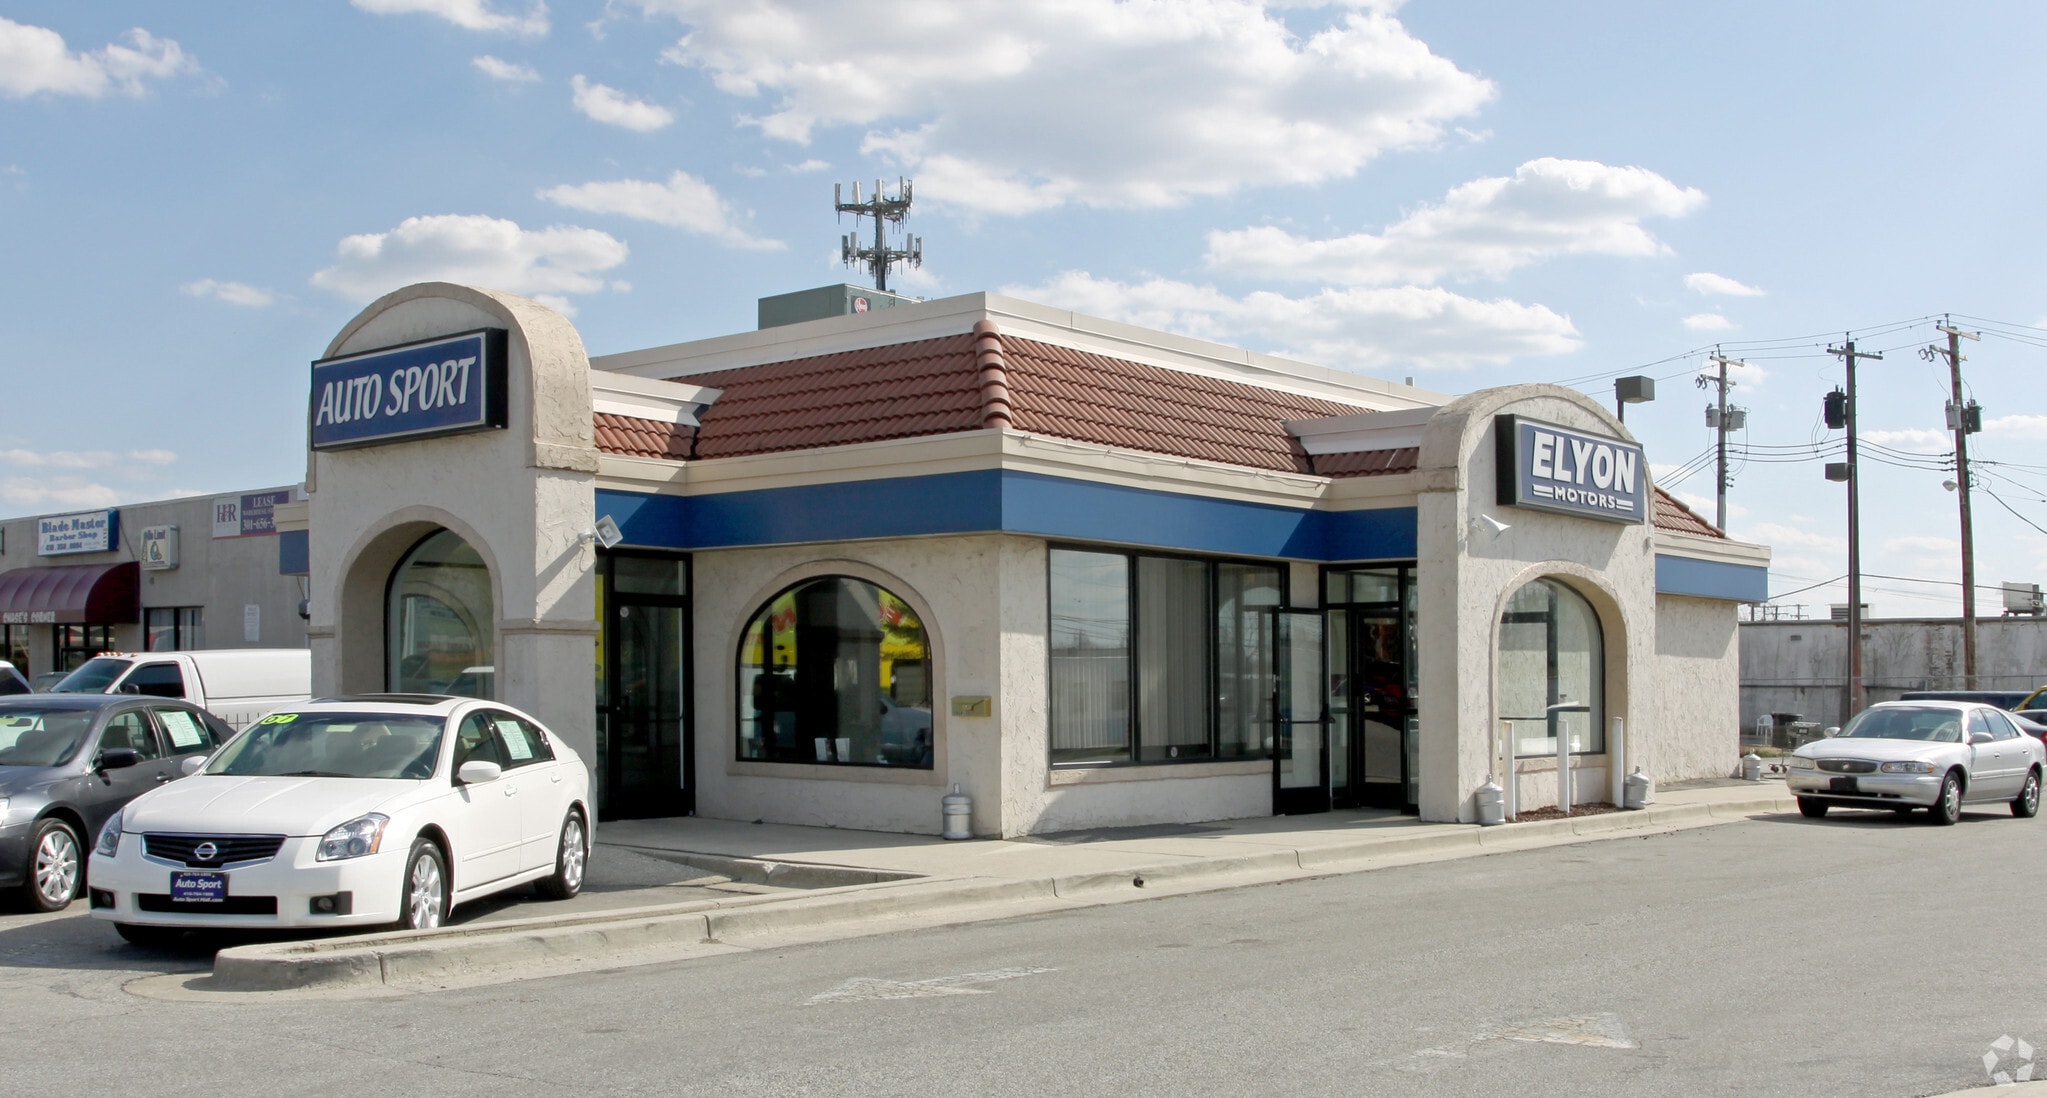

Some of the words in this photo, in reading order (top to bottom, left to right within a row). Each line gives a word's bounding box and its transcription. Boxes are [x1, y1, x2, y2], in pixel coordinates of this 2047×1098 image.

[316, 373, 382, 426] AUTO
[385, 356, 477, 416] SPORT
[1532, 431, 1636, 494] ELYON
[1554, 486, 1616, 509] MOTORS
[42, 520, 69, 533] Blade
[72, 518, 106, 530] Master
[50, 533, 76, 542] Barber
[78, 531, 98, 539] Shop
[175, 878, 196, 888] Auto
[197, 879, 222, 890] Sport
